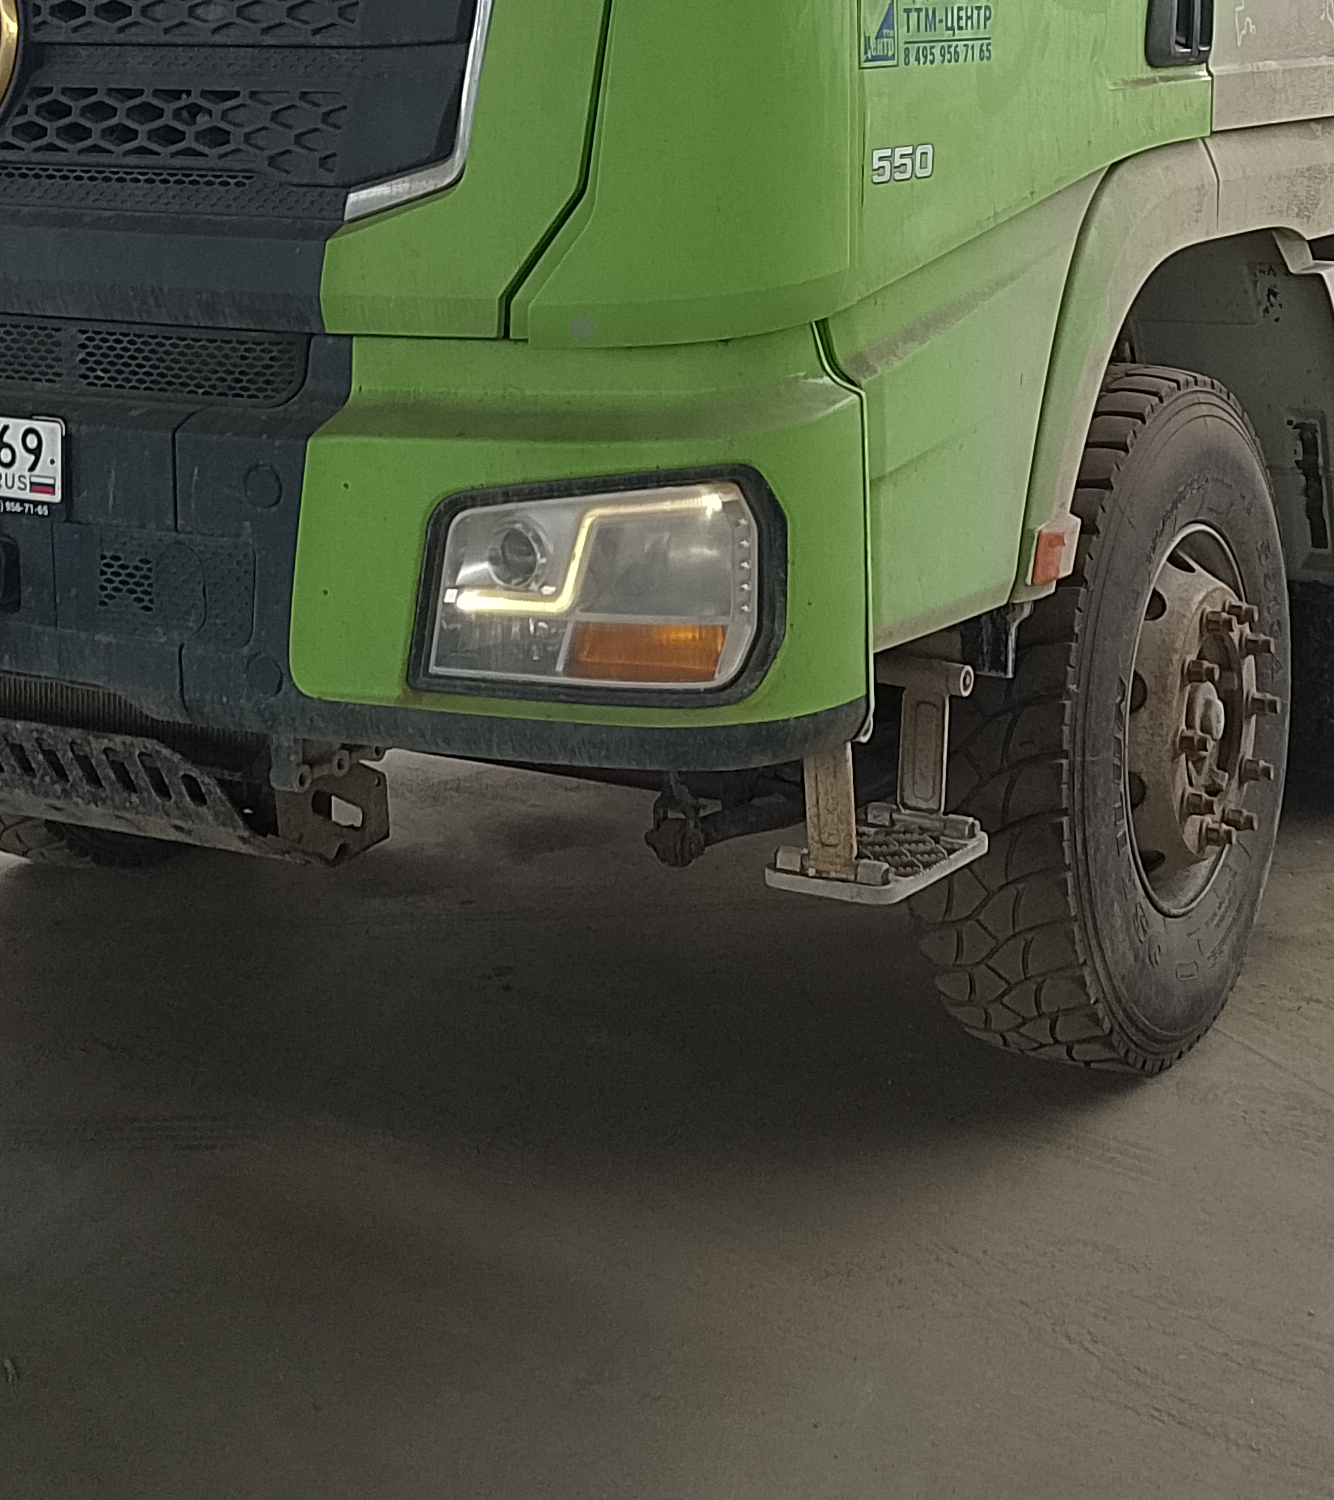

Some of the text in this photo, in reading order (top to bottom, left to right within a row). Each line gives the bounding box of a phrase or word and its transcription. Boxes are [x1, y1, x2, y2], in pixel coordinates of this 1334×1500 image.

[902, 4, 992, 37] ТТМ-ЦЕНТР
[903, 42, 992, 67] 8 495 956 71 65
[871, 143, 934, 184] 550
